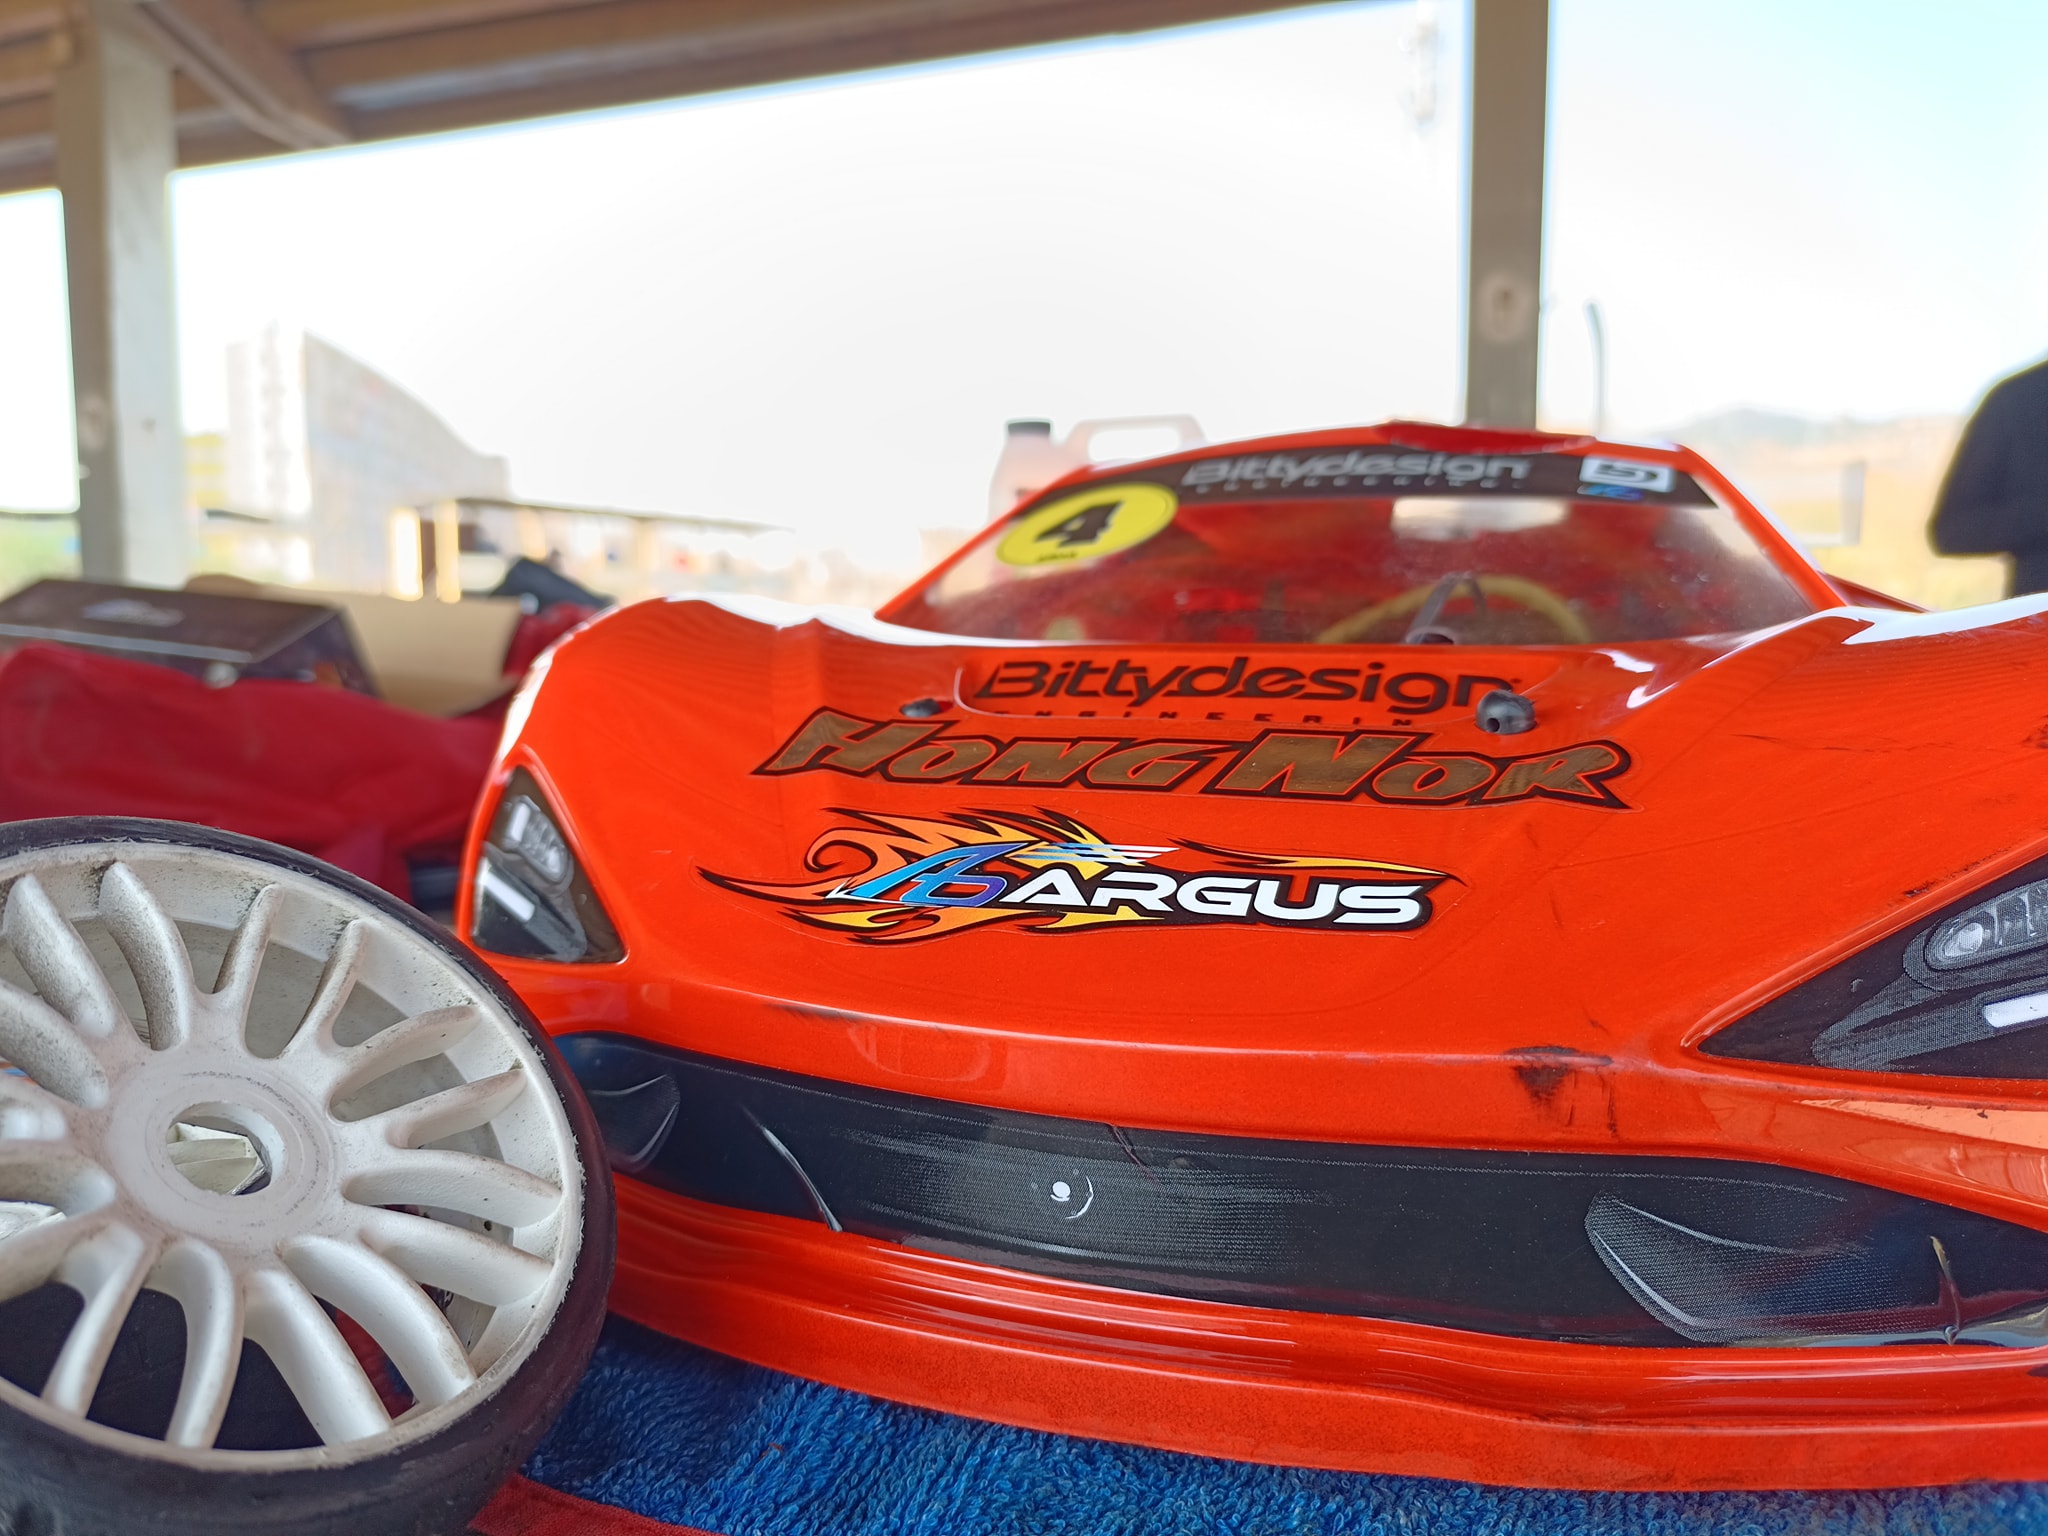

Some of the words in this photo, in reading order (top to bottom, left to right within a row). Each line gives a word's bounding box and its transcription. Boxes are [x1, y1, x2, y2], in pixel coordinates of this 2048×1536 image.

[1182, 452, 1532, 486] Bittydesign
[1034, 498, 1126, 548] 4
[974, 657, 1513, 714] Bittydesign
[752, 708, 1232, 790] HONG
[1202, 729, 1632, 807] NOR
